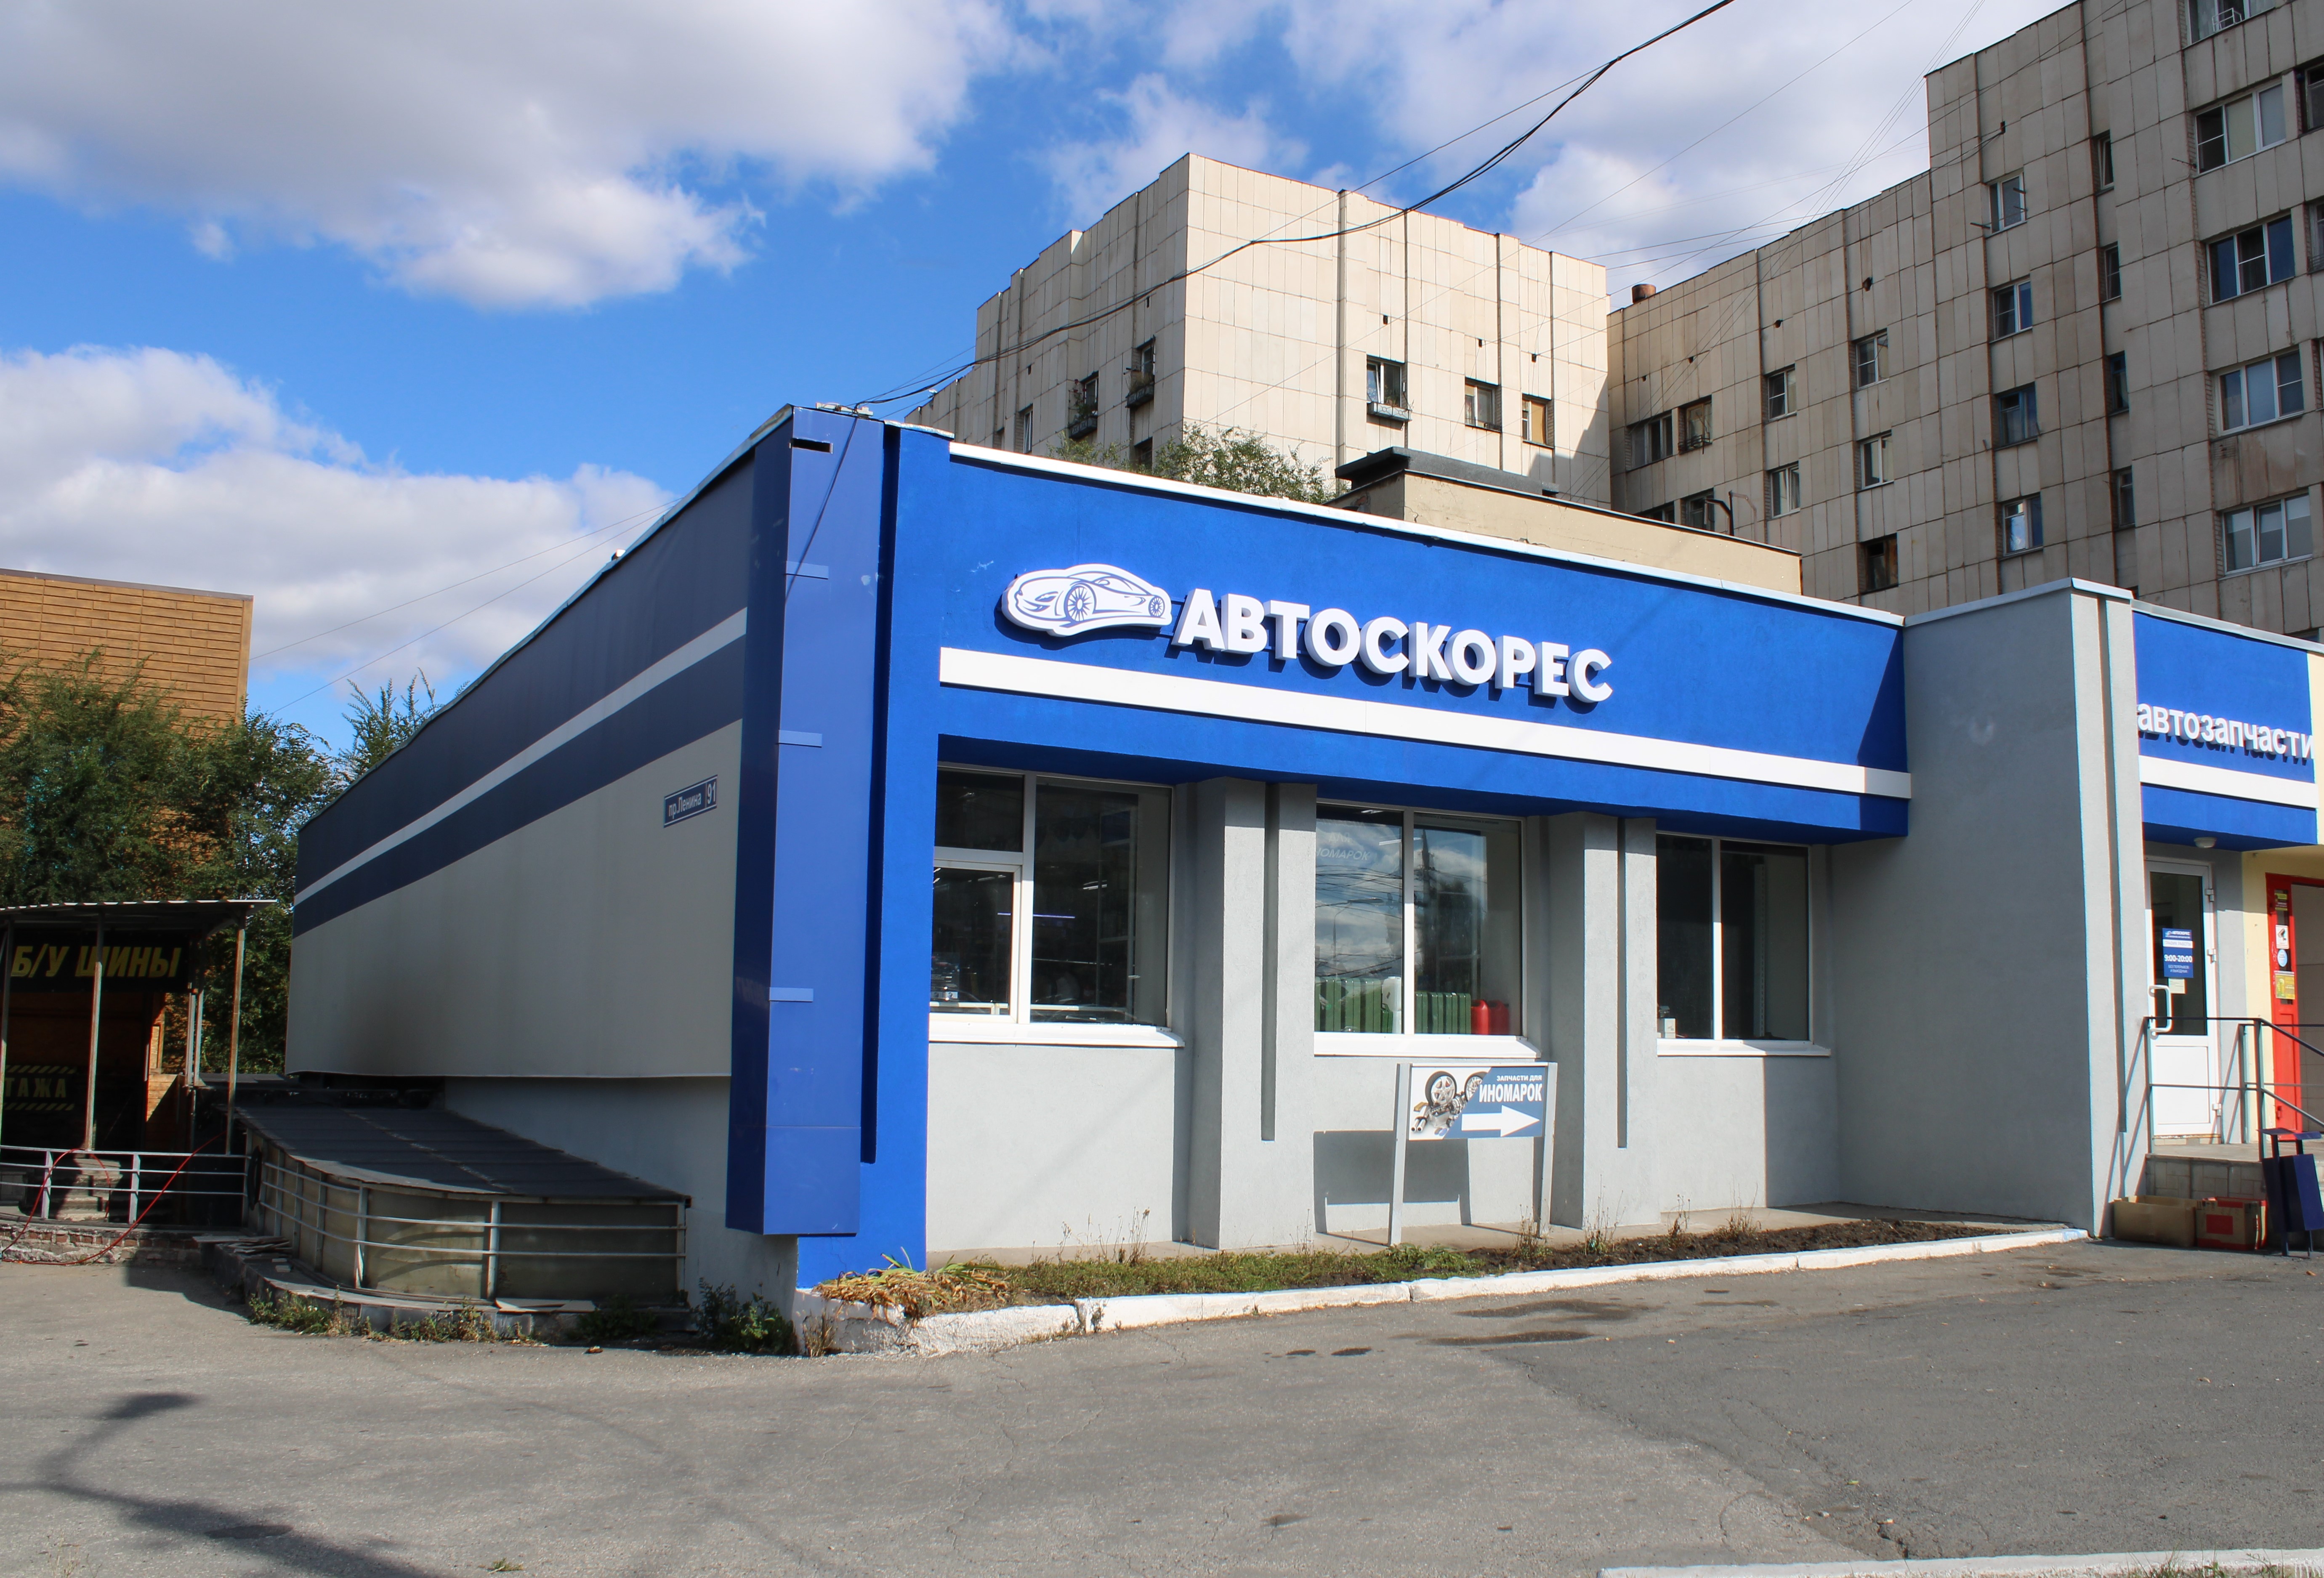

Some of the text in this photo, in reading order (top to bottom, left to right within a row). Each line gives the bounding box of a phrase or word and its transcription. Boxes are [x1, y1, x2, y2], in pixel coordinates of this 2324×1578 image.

[1171, 587, 1613, 704] АВТОСКОРЕС
[2137, 703, 2315, 759] автозапчасти
[669, 781, 716, 819] пр.Ленина 91
[1316, 847, 1370, 860] НОМАРОК
[11, 944, 182, 978] Б/У ШИНЫ
[2164, 954, 2193, 963] 9:00-20:00
[5, 1078, 66, 1098] ТАЖА
[1479, 1083, 1543, 1102] ИНОМАРОК
